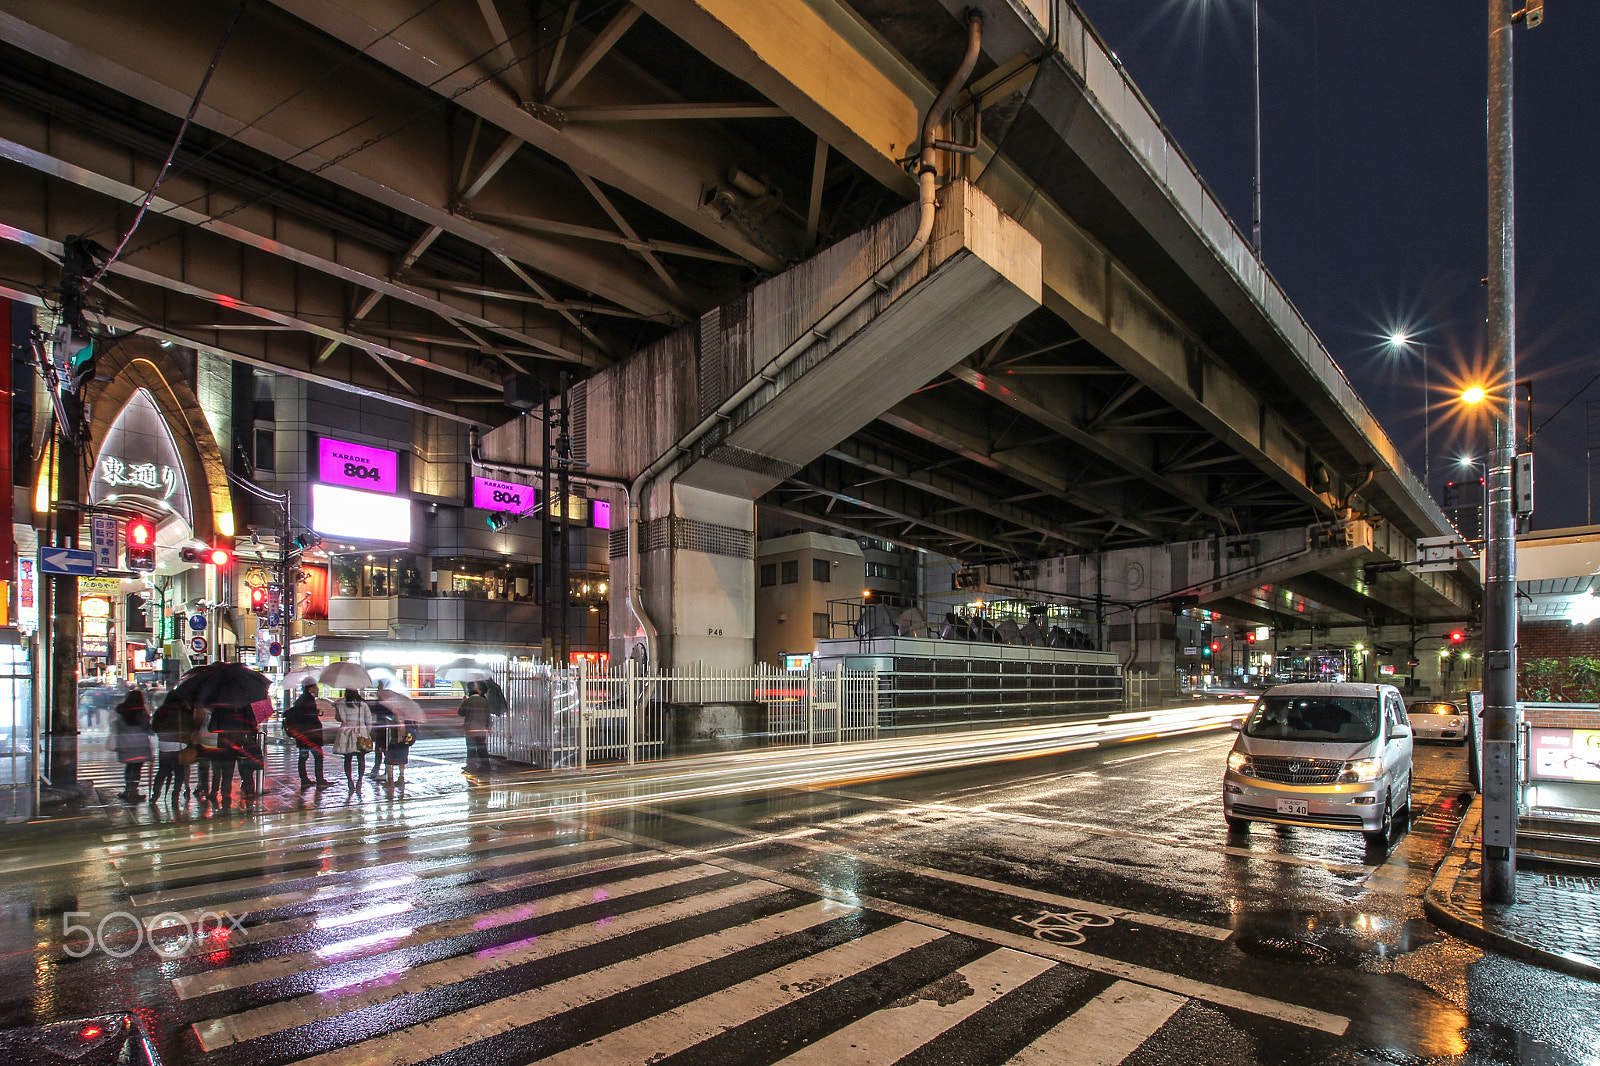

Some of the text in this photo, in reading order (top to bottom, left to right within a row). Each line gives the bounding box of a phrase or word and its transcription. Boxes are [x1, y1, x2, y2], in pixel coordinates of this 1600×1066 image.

[332, 452, 370, 463] KARAOKE
[101, 456, 176, 500] 東通り
[344, 463, 380, 481] 804
[484, 481, 513, 491] KARAOKE
[493, 491, 521, 506] 804
[708, 628, 723, 636] P46
